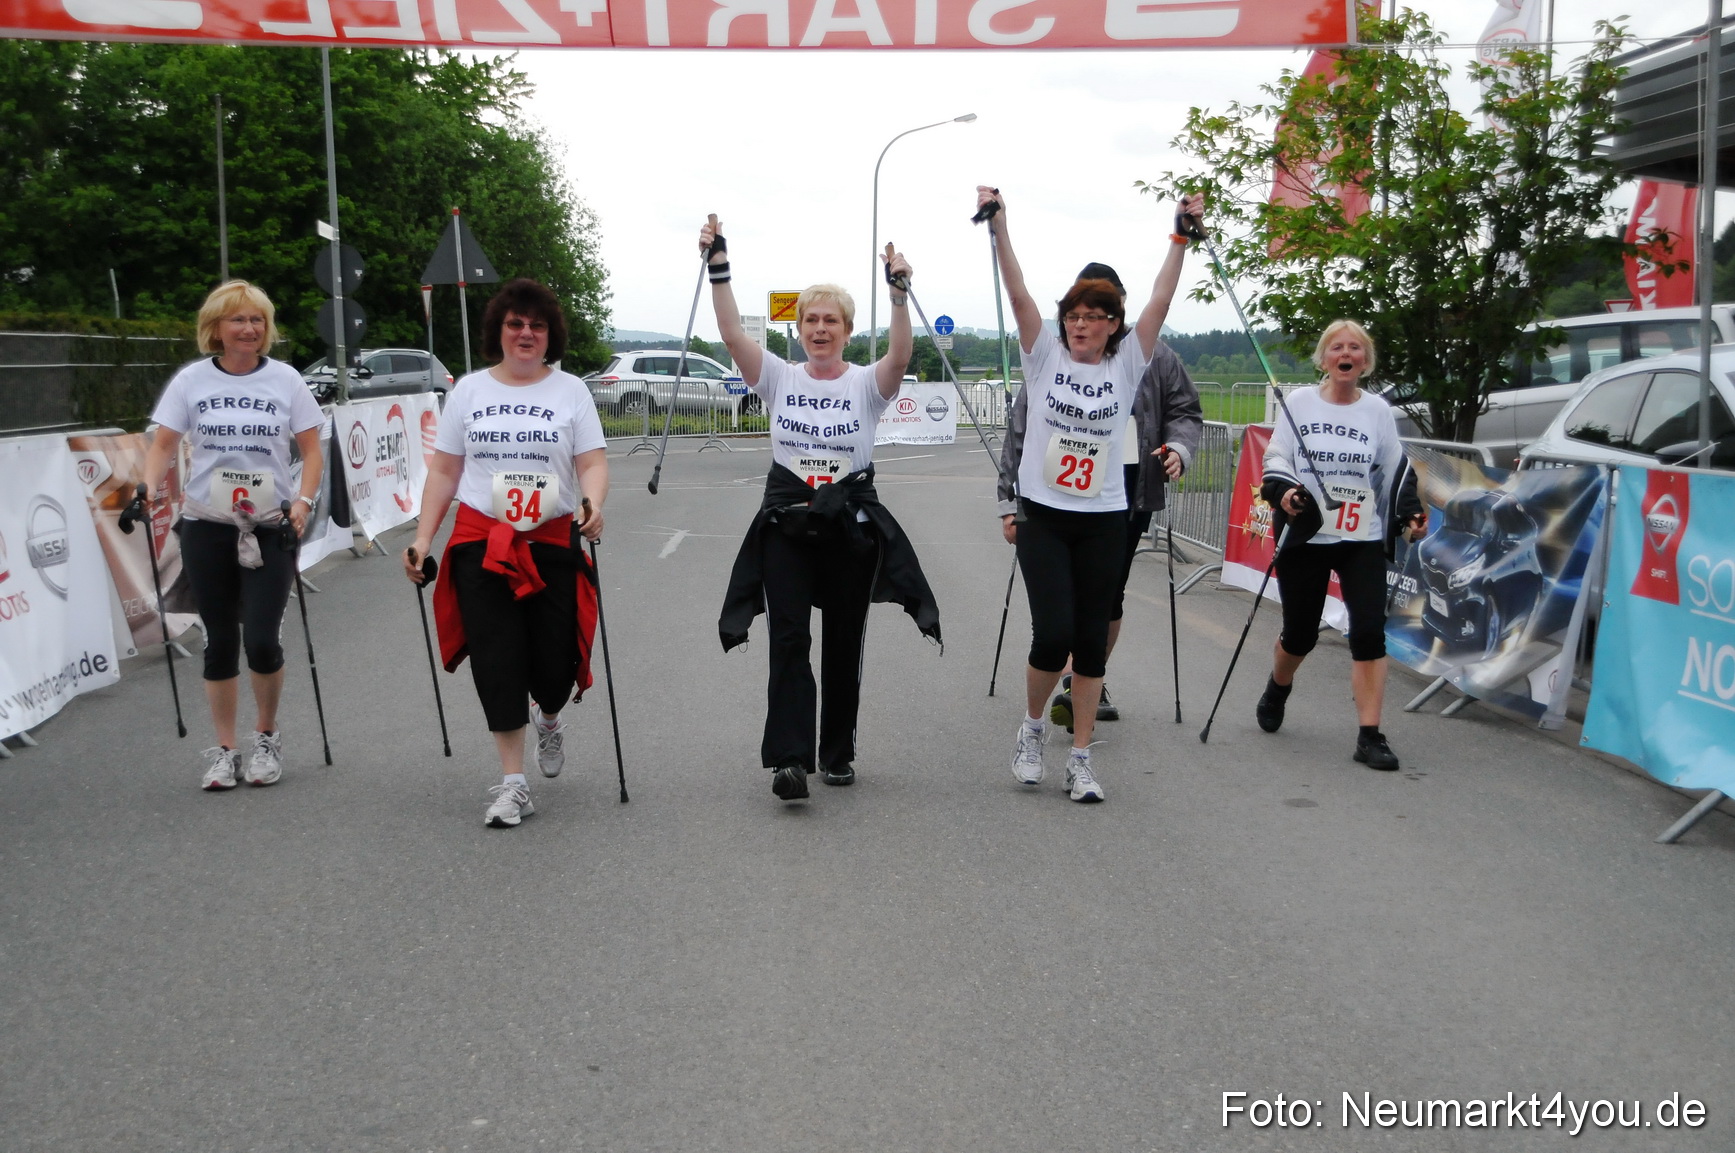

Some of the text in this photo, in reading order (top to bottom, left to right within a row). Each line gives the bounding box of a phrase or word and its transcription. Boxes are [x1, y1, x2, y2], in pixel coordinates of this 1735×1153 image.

[198, 397, 277, 416] BERGER
[786, 394, 851, 411] BERGER
[900, 402, 948, 413] KIA NISSAN
[472, 404, 555, 421] BERGER
[1088, 402, 1118, 421] GIRLS
[241, 424, 280, 437] GIRLS
[777, 415, 860, 438] POWER GIRLS
[1073, 426, 1087, 434] and
[516, 430, 559, 443] GIRLS
[1300, 422, 1369, 446] BERGER
[779, 440, 809, 450] walking
[1059, 438, 1088, 449] MEYER
[245, 445, 272, 456] talking
[1058, 445, 1087, 455] WERBUNG
[521, 452, 549, 463] talking
[1338, 452, 1372, 464] GIRLS
[222, 472, 250, 480] MEYER
[1055, 454, 1095, 490] 23
[1340, 469, 1365, 479] talking
[1331, 486, 1357, 495] MEYER
[506, 488, 542, 523] 34
[1335, 501, 1361, 532] 15
